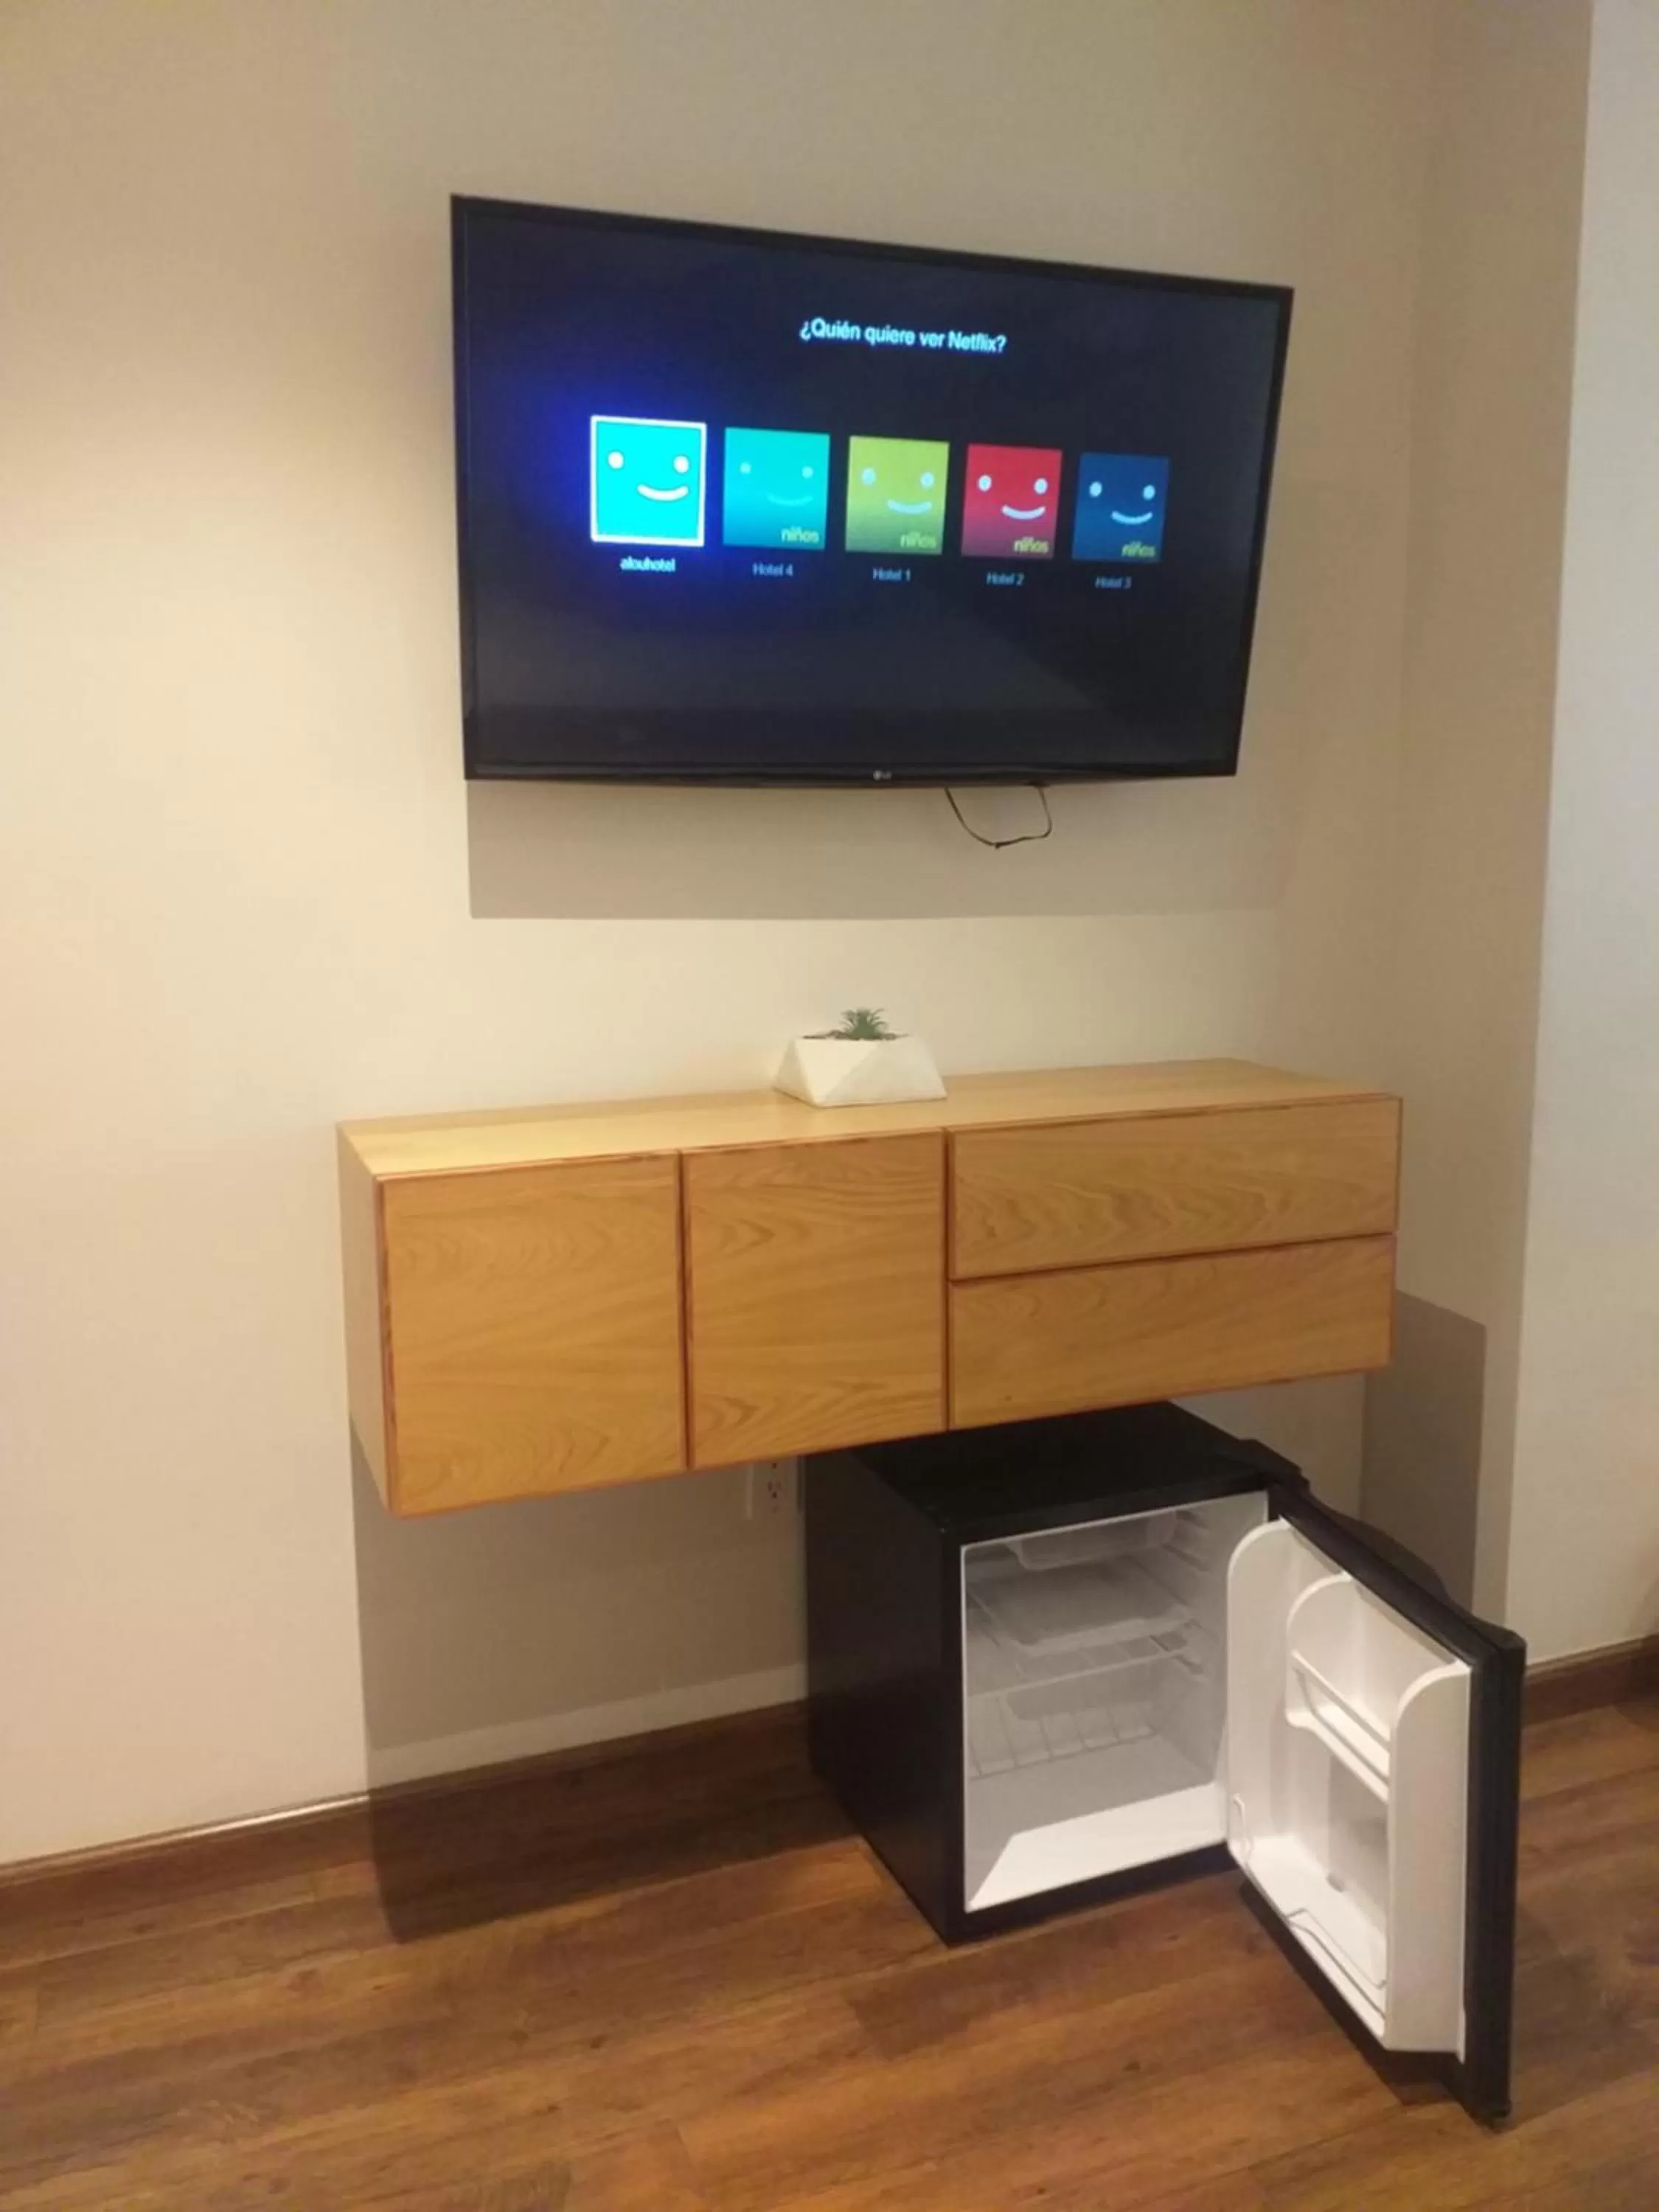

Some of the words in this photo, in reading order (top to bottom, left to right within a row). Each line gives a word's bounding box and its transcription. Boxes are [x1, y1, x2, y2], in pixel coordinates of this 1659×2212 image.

[800, 317, 860, 341] ¿Quién
[865, 325, 915, 346] quiere
[919, 332, 945, 348] ver
[948, 330, 1007, 352] Netflix?
[781, 526, 820, 543] niños
[1013, 537, 1050, 553] niños
[753, 562, 782, 577] Hotel
[785, 564, 793, 577] 4
[872, 567, 900, 581] Hotel
[904, 568, 911, 581] 1
[987, 571, 1014, 585] Hotel
[1016, 573, 1024, 585] 2
[1095, 576, 1121, 589] Hotel
